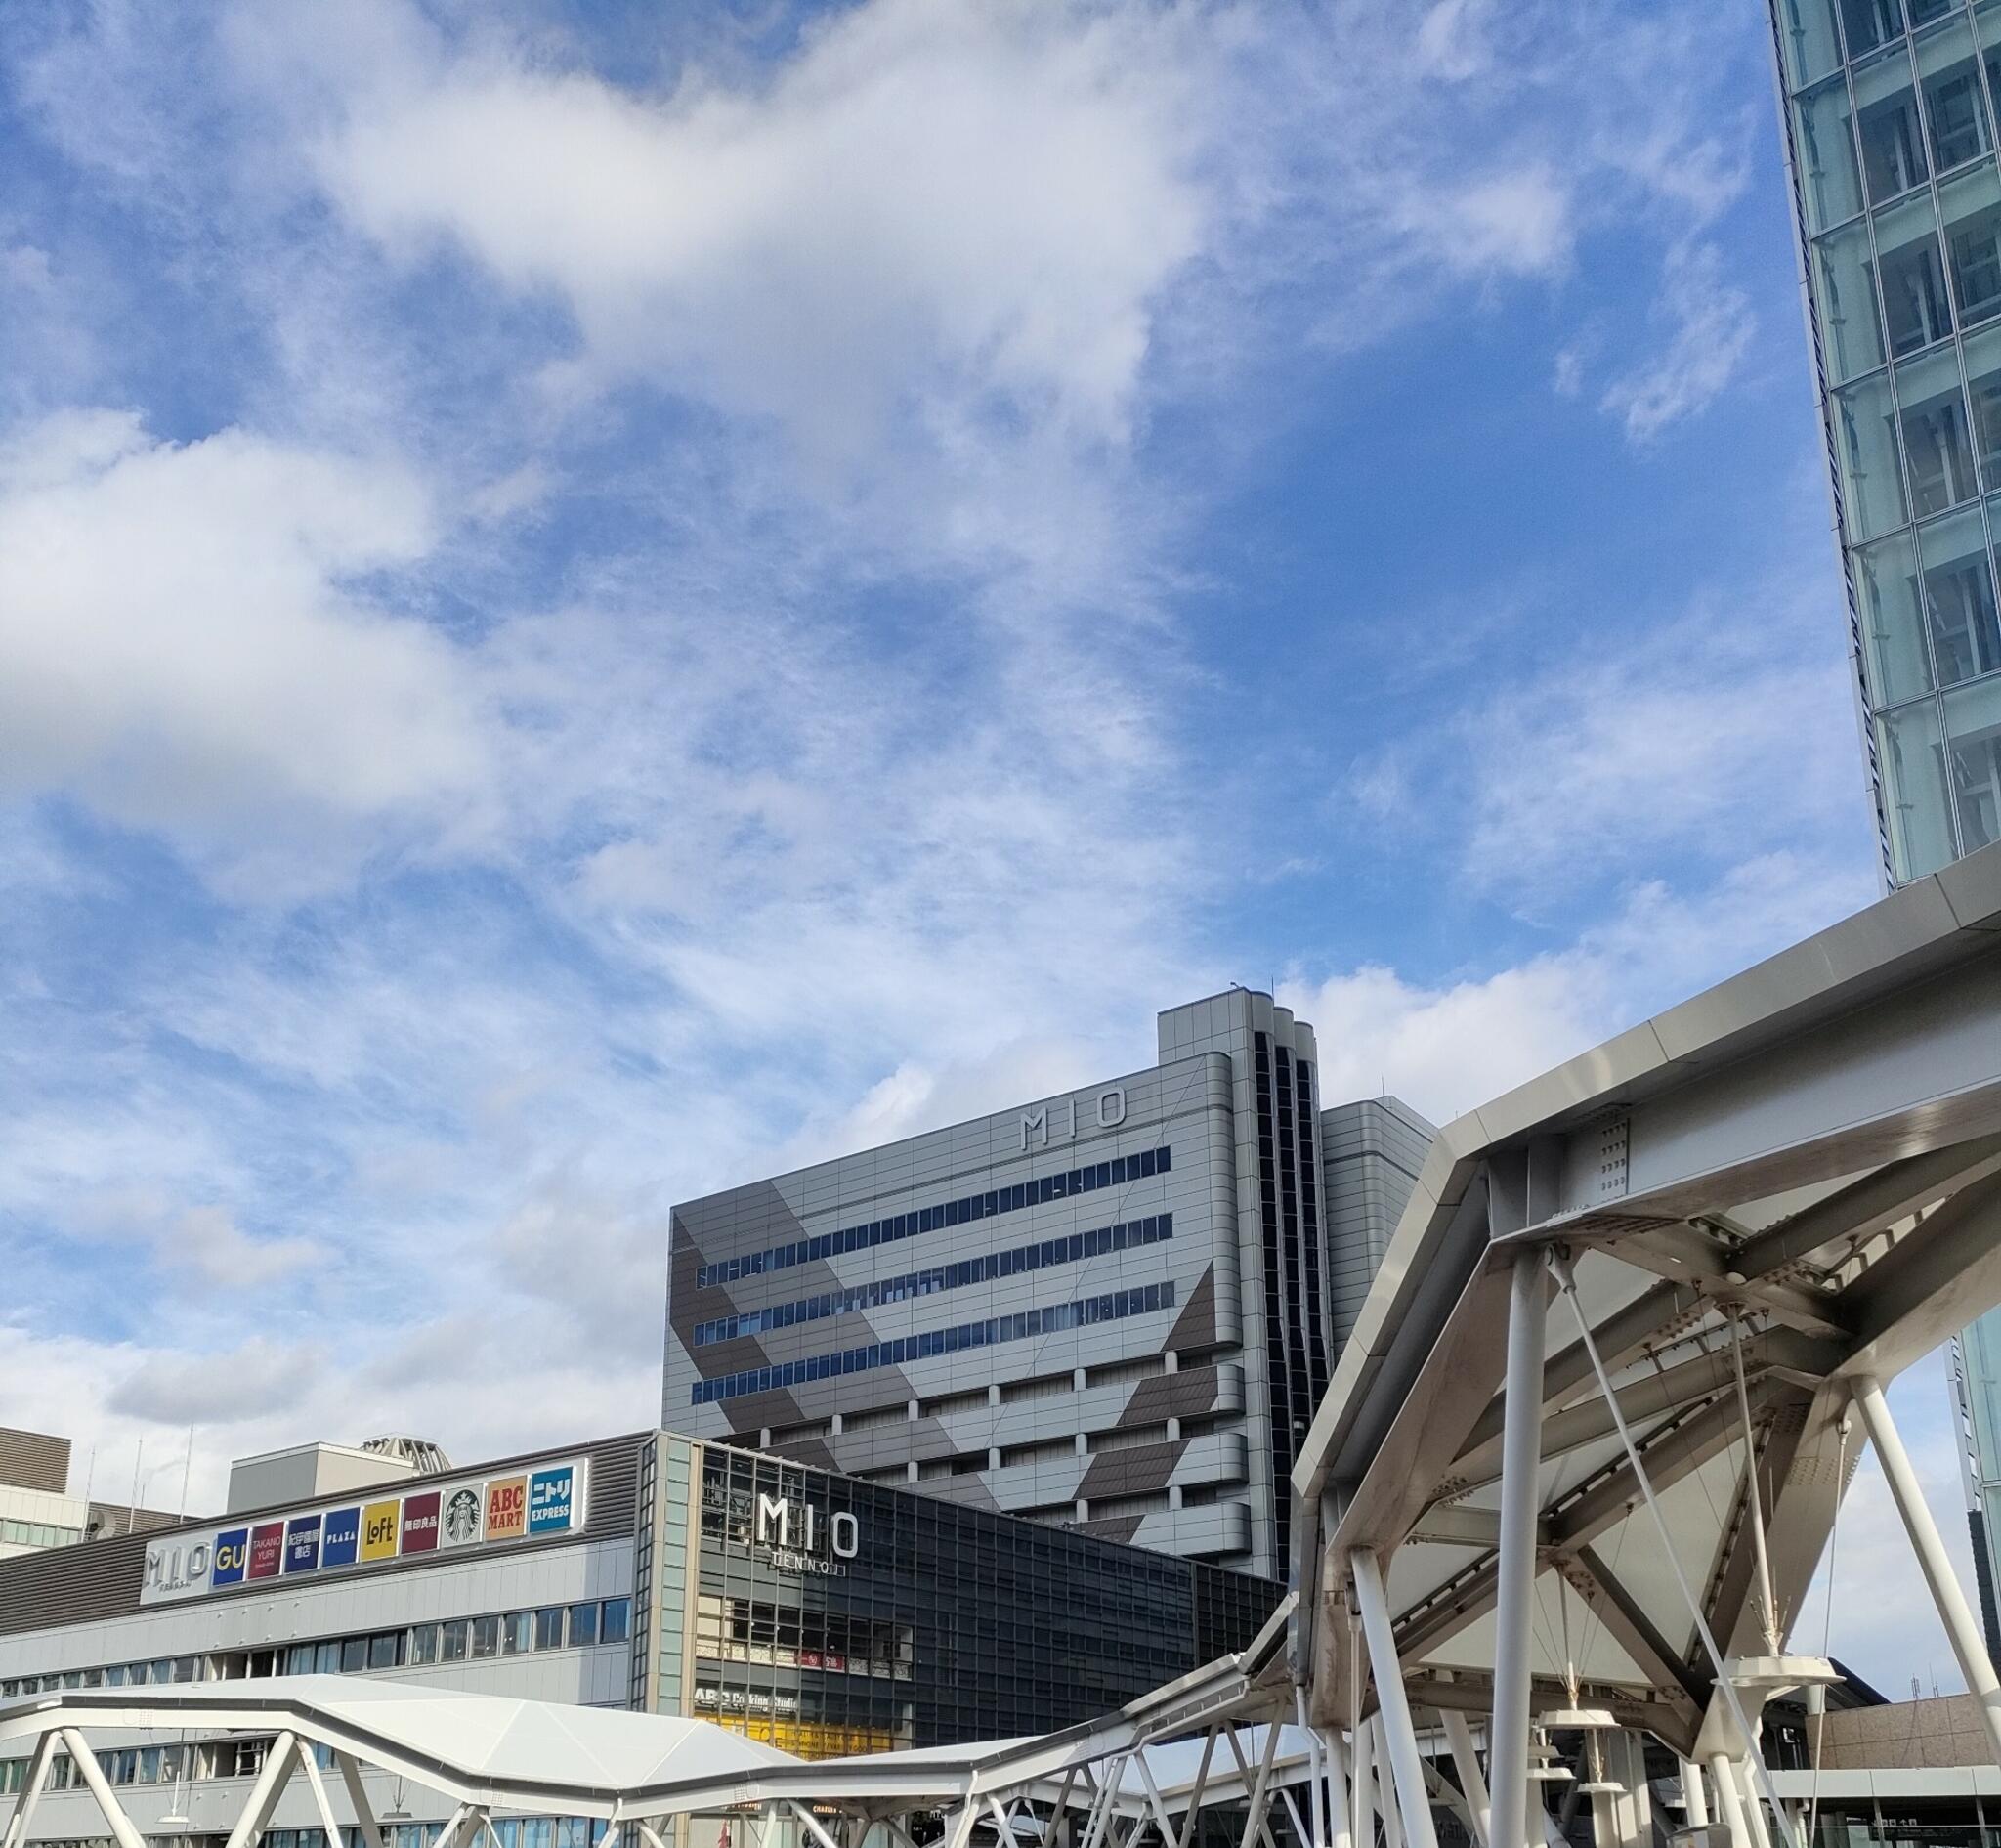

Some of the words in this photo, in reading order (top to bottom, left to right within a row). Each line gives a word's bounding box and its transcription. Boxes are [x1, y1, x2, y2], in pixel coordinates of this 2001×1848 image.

[1021, 1087, 1127, 1151] MIO
[489, 1486, 523, 1514] ABC
[532, 1479, 571, 1506] ニトリ
[404, 1516, 438, 1532] 無印良品
[488, 1511, 523, 1531] MART
[531, 1505, 570, 1521] EXPRESS
[758, 1493, 859, 1559] MIO
[252, 1536, 281, 1550] TAKANO
[326, 1530, 356, 1545] PLAZA
[145, 1541, 211, 1585] MIO
[216, 1544, 245, 1571] GU
[258, 1549, 275, 1561] YURI
[295, 1544, 311, 1560] 書店
[694, 1688, 731, 1705] ABC
[732, 1692, 769, 1712] Coking
